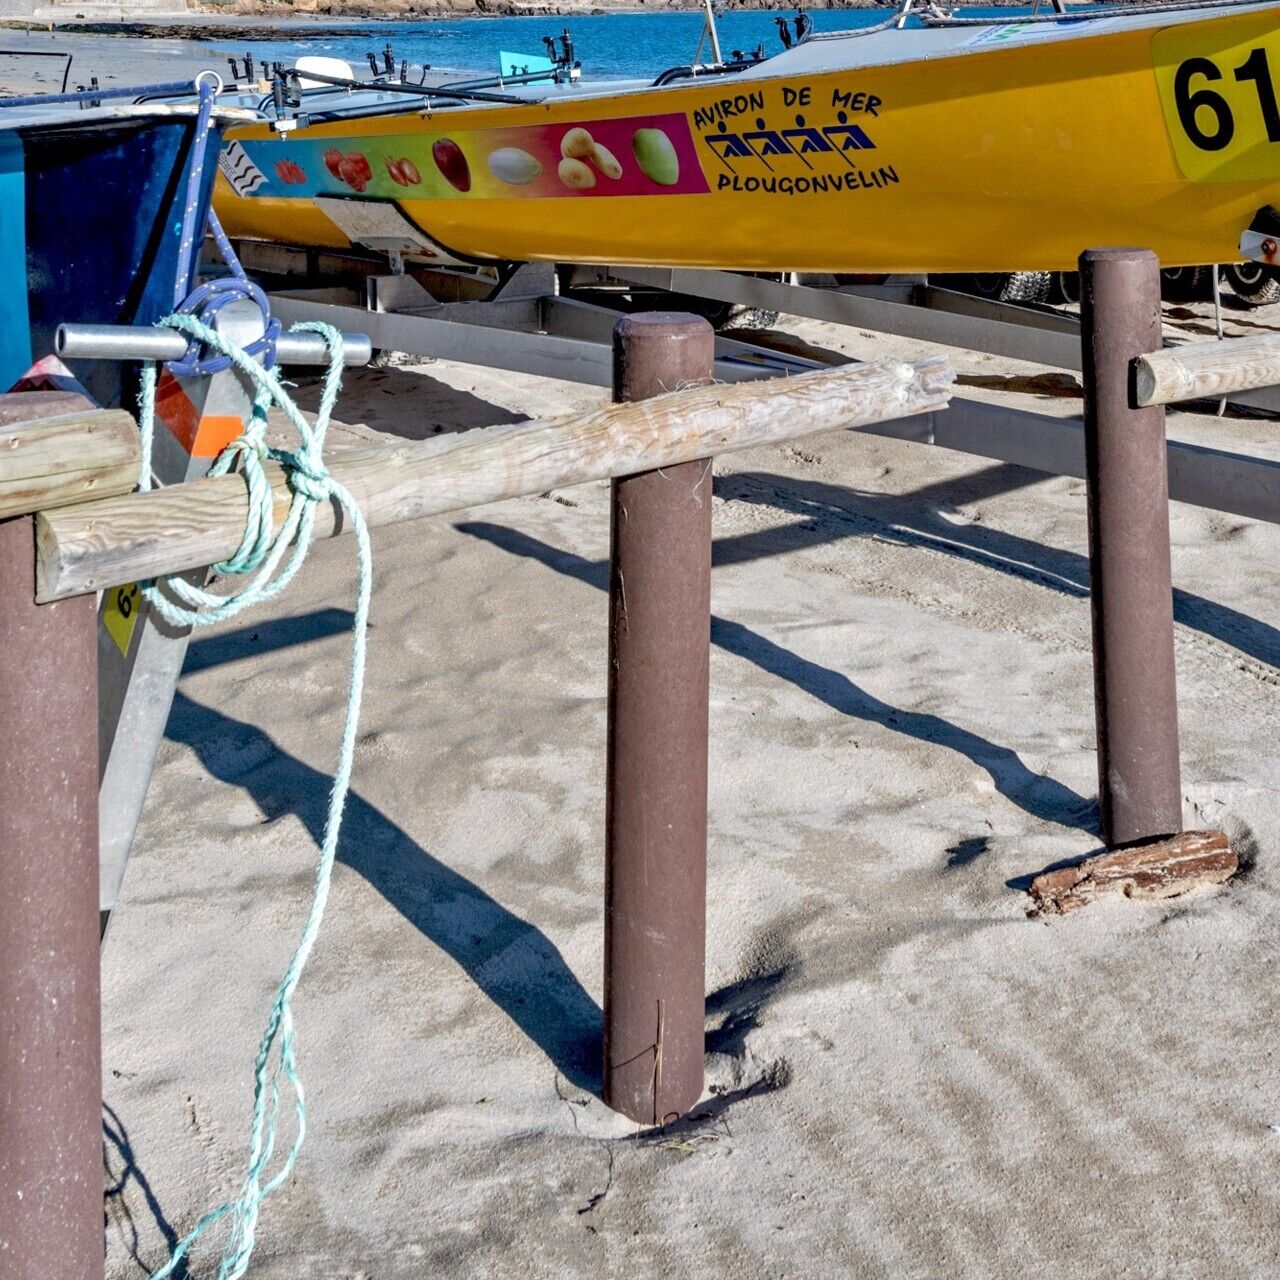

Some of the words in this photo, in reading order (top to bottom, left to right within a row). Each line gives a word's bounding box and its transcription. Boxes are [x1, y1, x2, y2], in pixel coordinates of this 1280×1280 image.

[693, 90, 764, 131] AVIRON
[782, 86, 811, 107] DE
[831, 88, 883, 118] MER
[717, 165, 900, 196] PLOUGONVELIN
